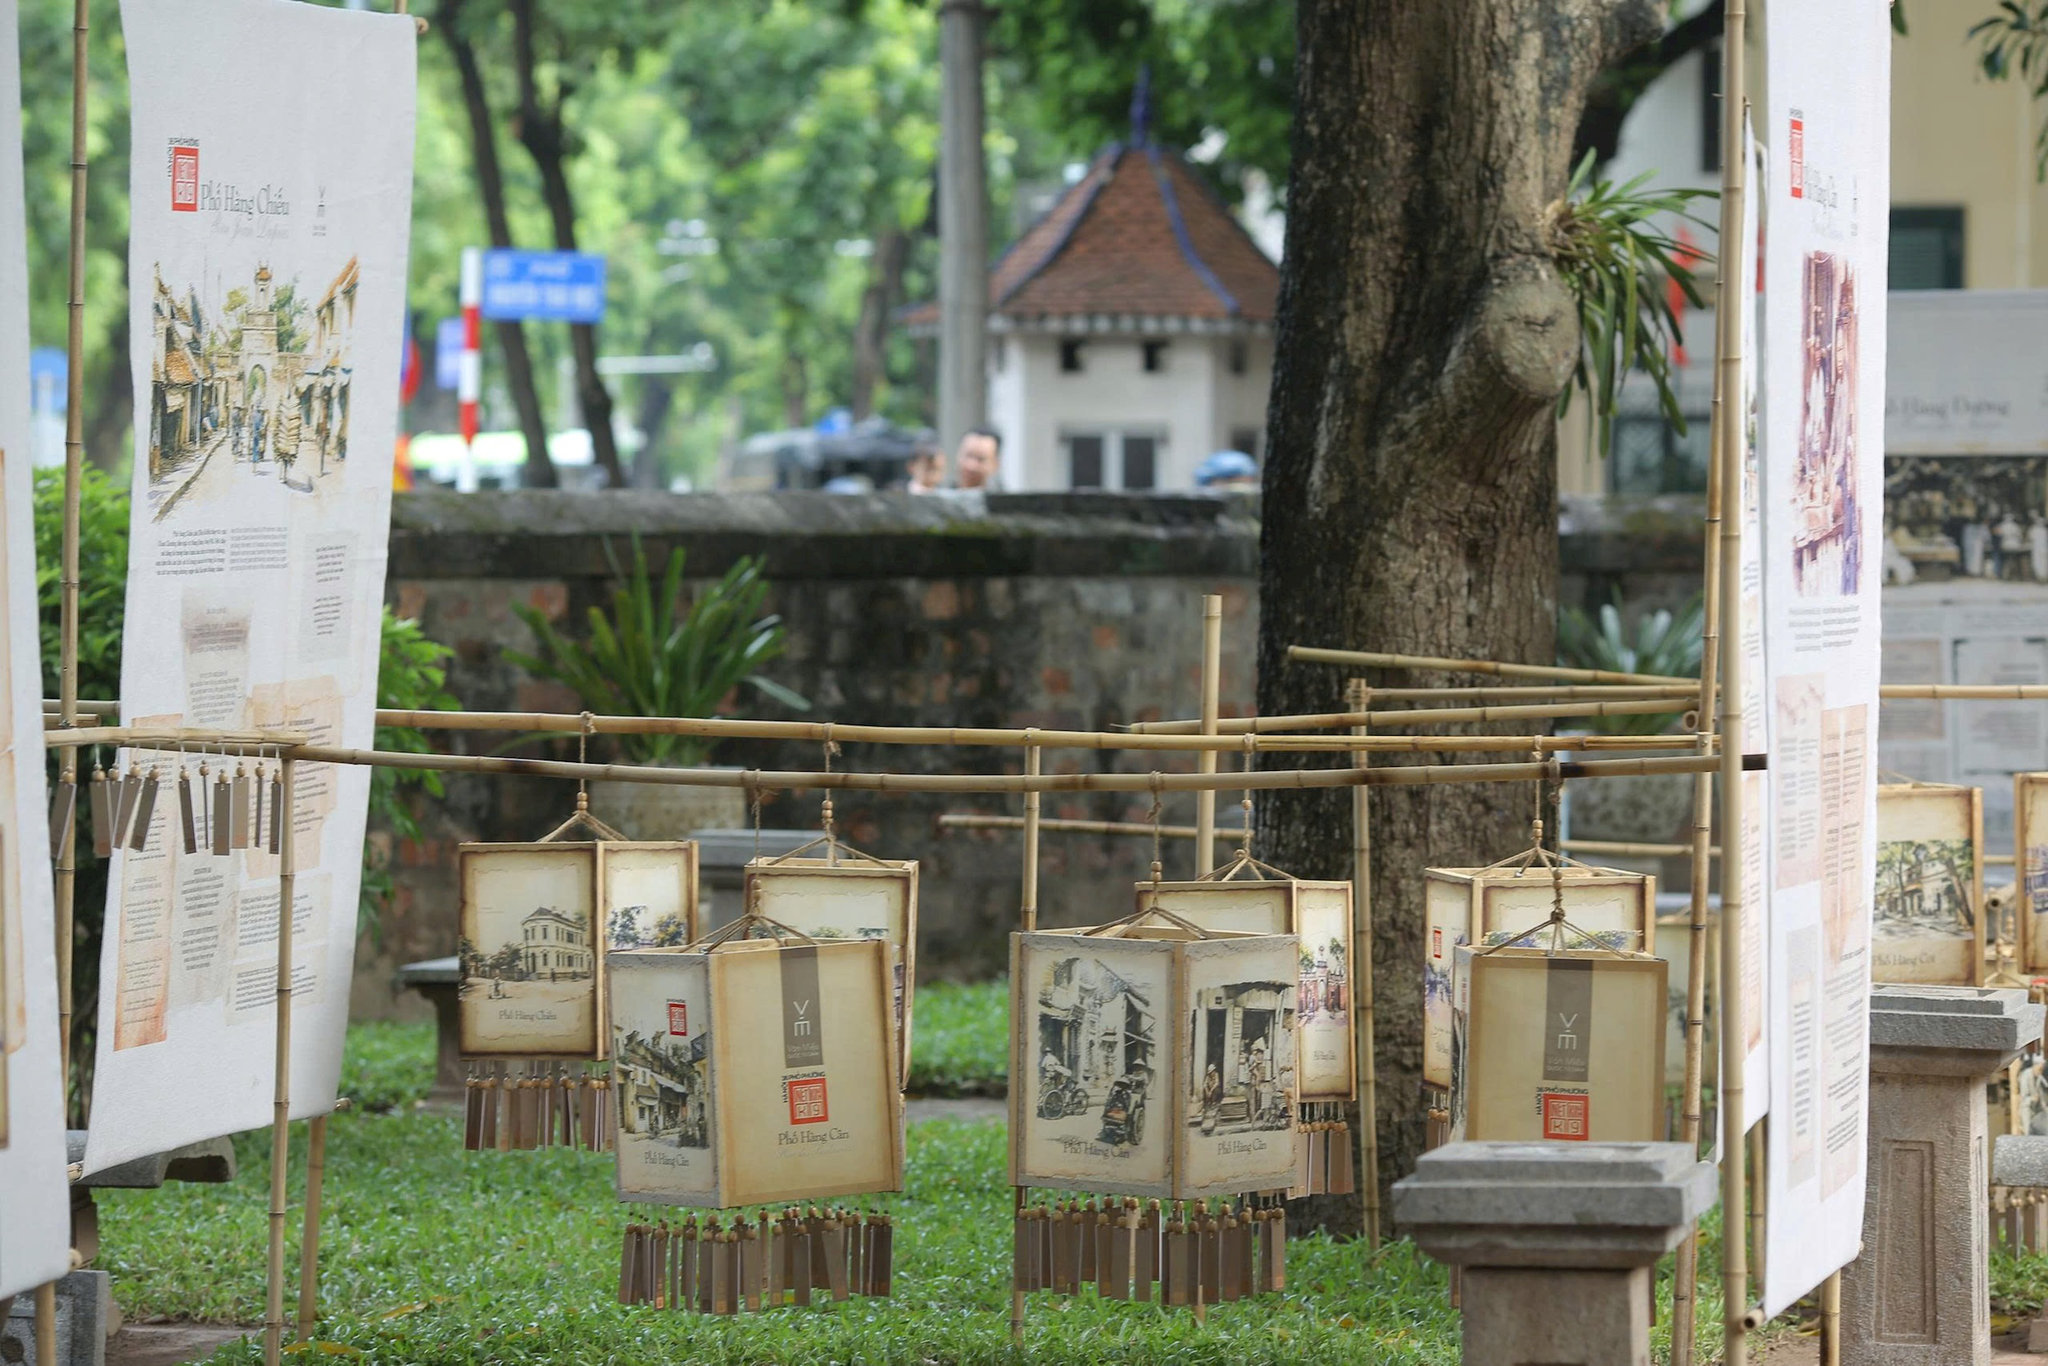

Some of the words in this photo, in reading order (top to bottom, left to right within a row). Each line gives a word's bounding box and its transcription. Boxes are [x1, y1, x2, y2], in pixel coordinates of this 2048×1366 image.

[224, 184, 255, 221] Hàng
[778, 1130, 799, 1146] Phố
[800, 1129, 827, 1145] Hàng
